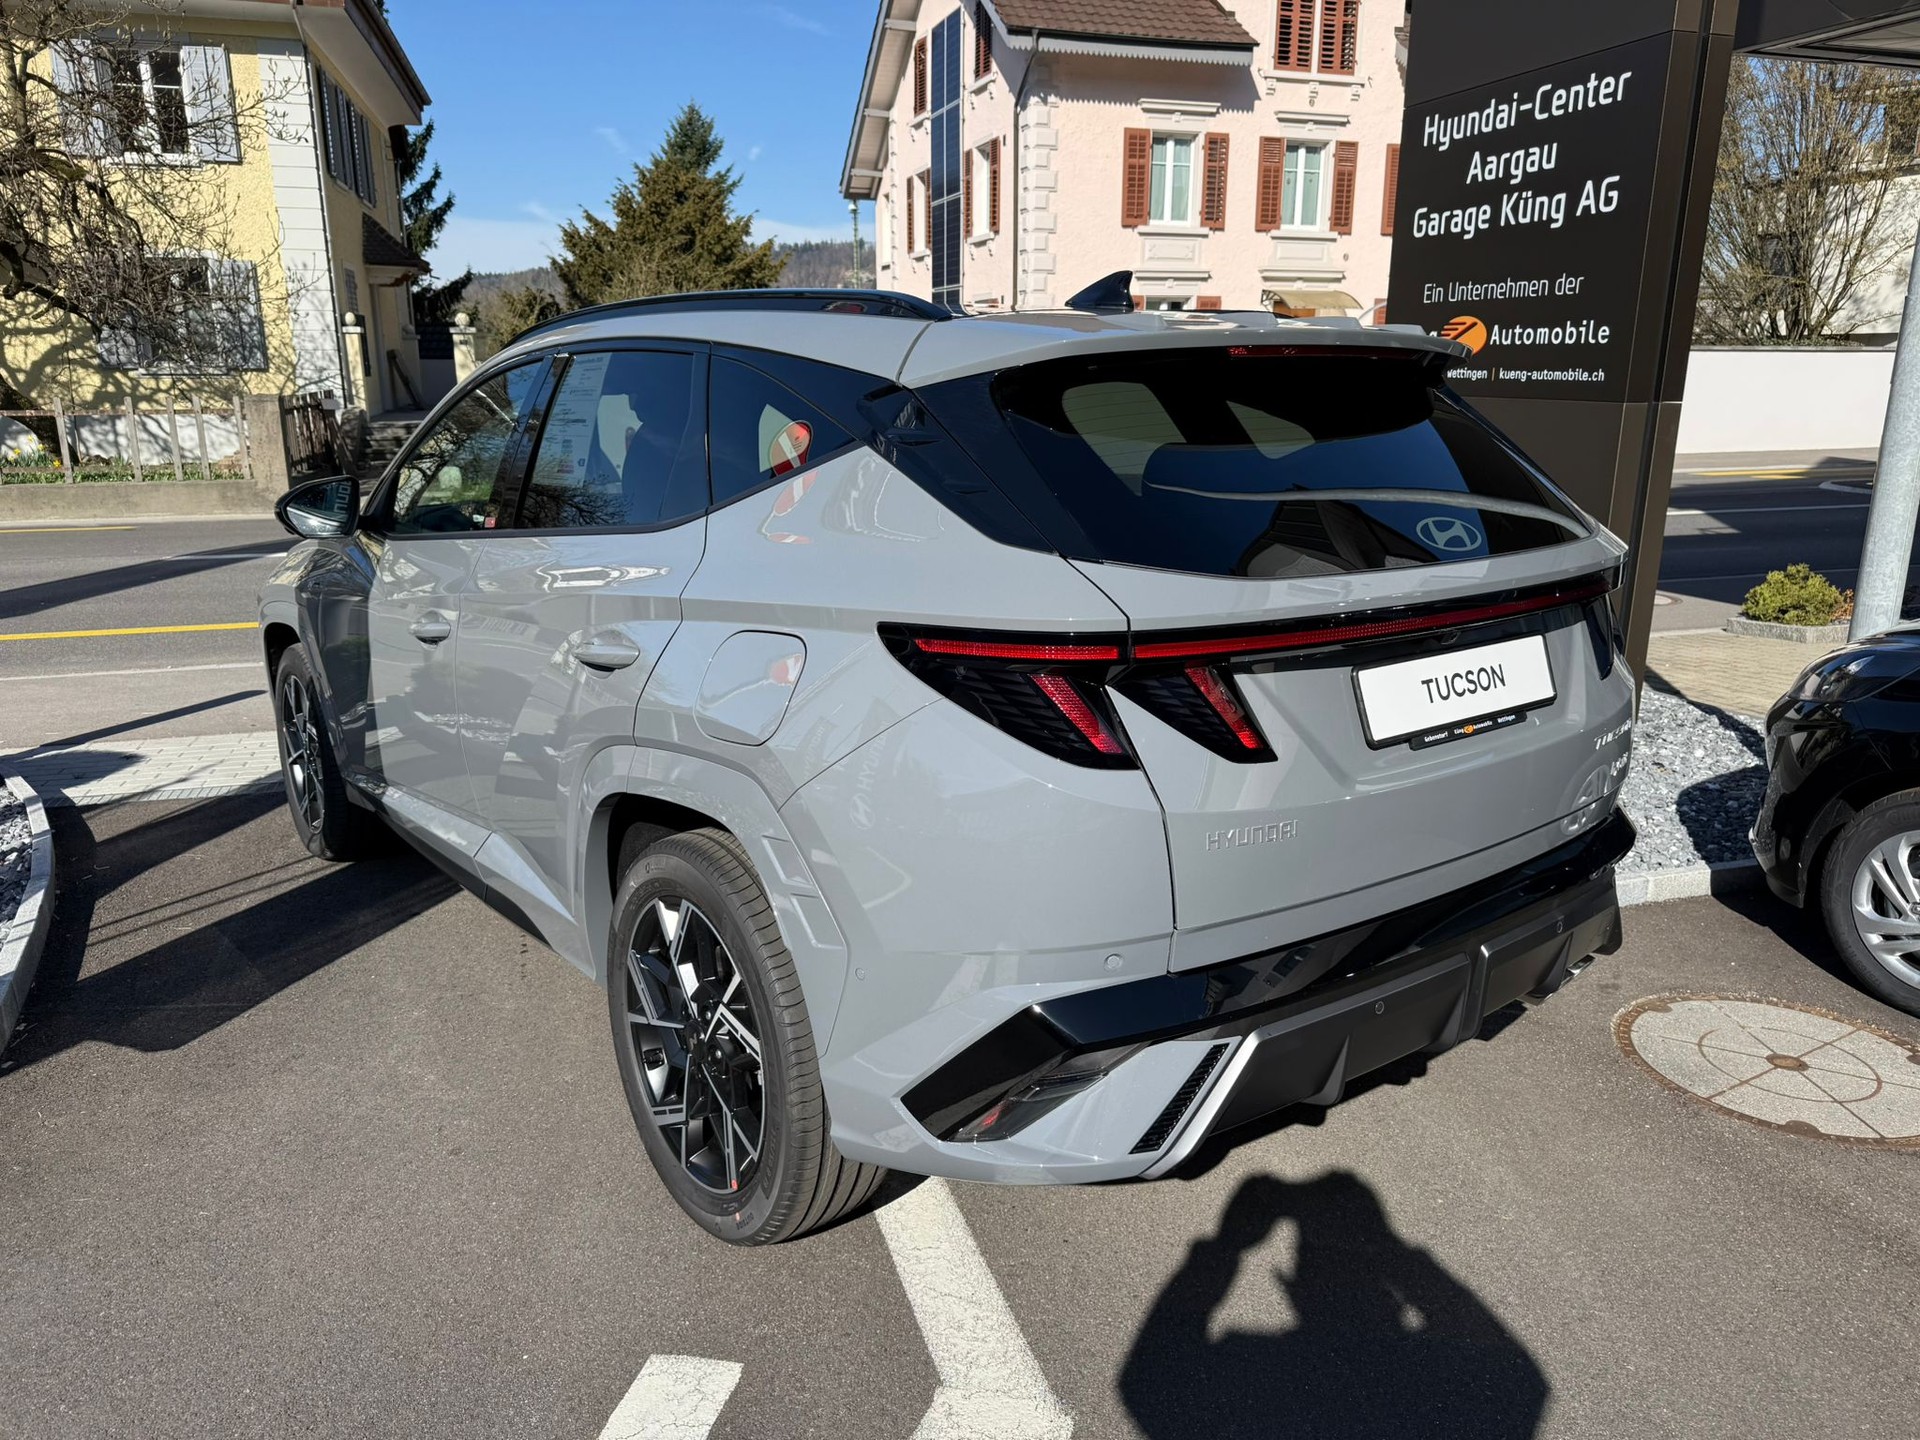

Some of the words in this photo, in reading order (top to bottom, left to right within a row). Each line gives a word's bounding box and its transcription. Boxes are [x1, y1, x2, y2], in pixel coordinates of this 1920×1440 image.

[1423, 71, 1633, 152] Hyundai-Center
[1465, 142, 1558, 185] Aargau
[1412, 204, 1492, 240] Garage
[1500, 190, 1567, 229] Küng
[1575, 175, 1621, 217] AG
[1423, 282, 1444, 304] Ein
[1448, 278, 1549, 302] Unternehmen
[1554, 272, 1585, 296] der
[1489, 319, 1611, 346] Automobile
[1498, 367, 1605, 383] kueng-automobile.ch
[1420, 663, 1506, 704] TUCSON
[1206, 819, 1299, 851] HYUNDAI
